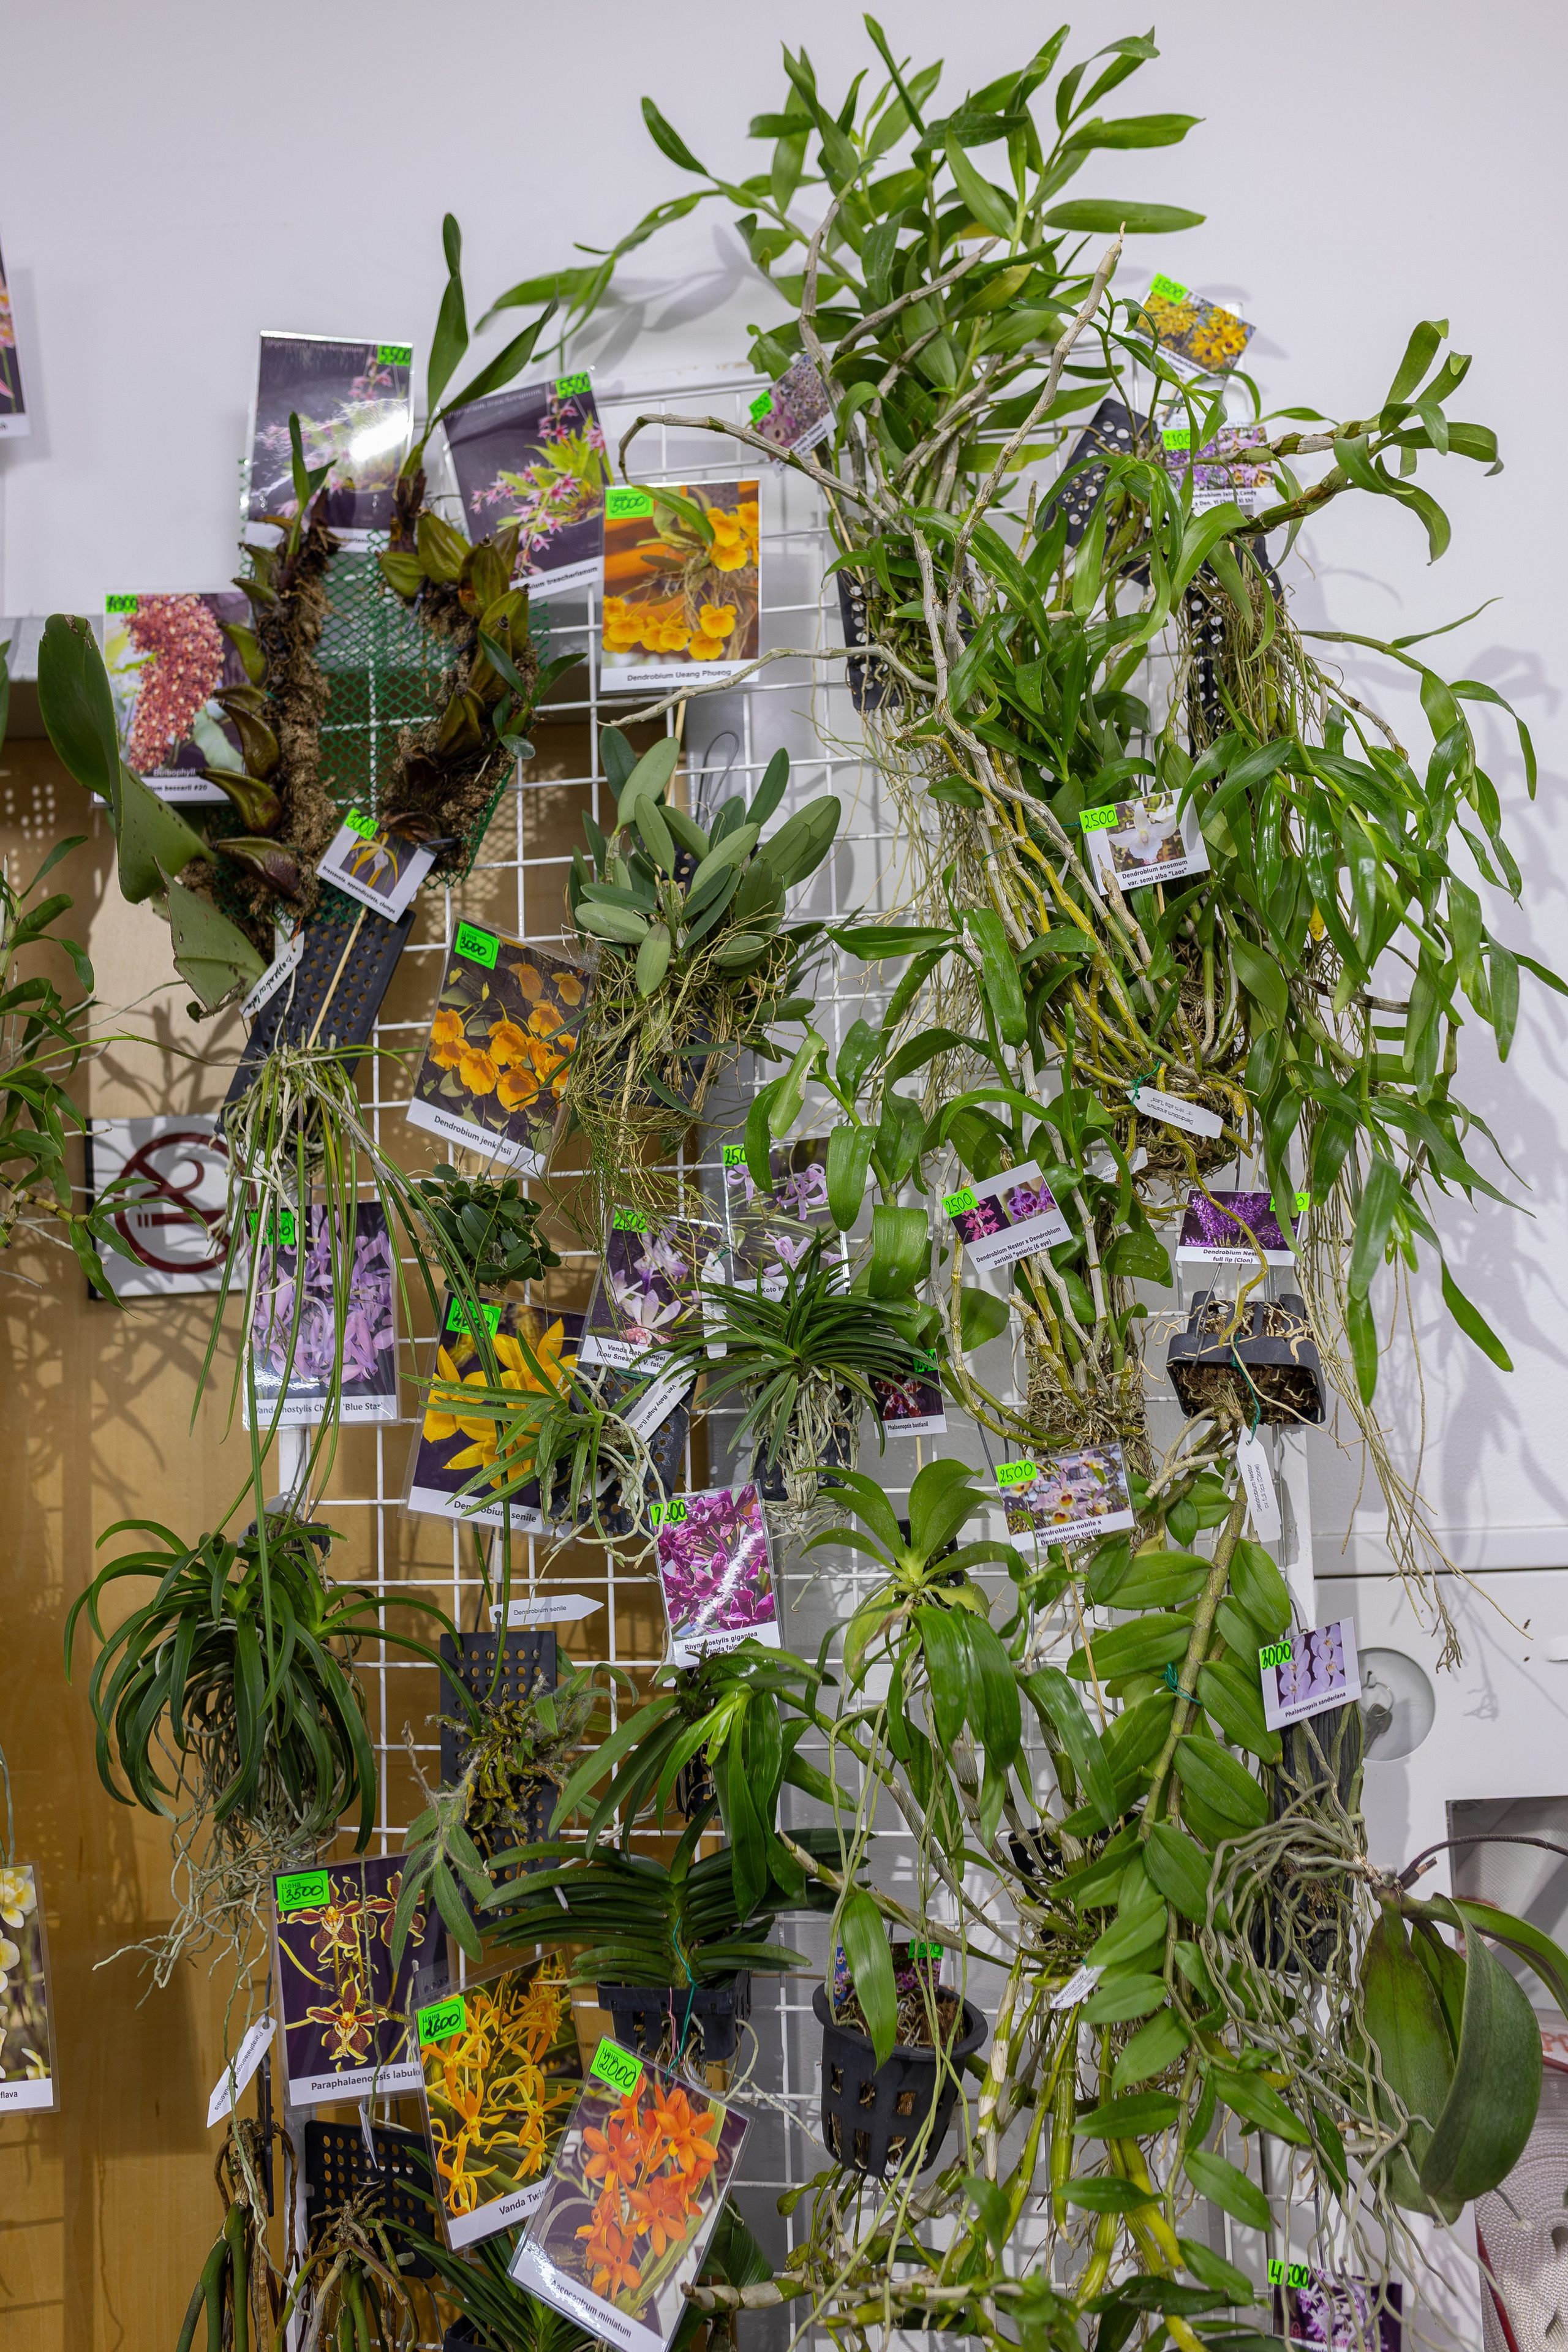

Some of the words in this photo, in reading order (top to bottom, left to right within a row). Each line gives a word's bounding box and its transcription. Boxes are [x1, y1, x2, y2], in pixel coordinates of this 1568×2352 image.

[627, 673, 674, 681] Dendrobium
[676, 671, 700, 679] Ueang
[153, 768, 196, 778] Bulbophyll
[1084, 809, 1115, 829] 2500
[1121, 867, 1158, 880] Dendrobium
[1159, 859, 1188, 870] anosmum
[1155, 872, 1167, 881] alba
[460, 937, 487, 956] 3000
[434, 1115, 480, 1141] Dendrobium
[725, 1147, 747, 1165] 250
[945, 1192, 972, 1215] 2500
[976, 1248, 1008, 1263] Dendrobium
[1007, 1240, 1025, 1251] Nestor
[1028, 1226, 1061, 1242] Dendrobium
[993, 1253, 1013, 1266] parishii
[1040, 1238, 1052, 1250] eye)
[608, 1344, 627, 1354] Vanda
[656, 1395, 668, 1407] Baby
[645, 1406, 658, 1422] Angel
[1000, 1463, 1033, 1483] 2500
[454, 1501, 505, 1517] Denobiu
[511, 1512, 537, 1523] senile
[1036, 1526, 1075, 1539] Dendrobium
[1076, 1520, 1096, 1530] nobile
[1041, 1533, 1080, 1546] Dendrobium
[1081, 1528, 1101, 1537] tortile
[513, 1607, 548, 1616] Dendrobium
[684, 1638, 729, 1651] Rhyncostylis
[730, 1631, 758, 1643] gigantea
[1261, 1642, 1292, 1670] 3000
[1284, 1702, 1317, 1718] Phalaenopsis
[1318, 1692, 1346, 1706] sanderiana
[285, 1885, 323, 1903] 3500
[425, 2013, 459, 2037] 2600
[599, 2052, 637, 2087] 2000
[499, 2198, 526, 2215] Vanda
[598, 2310, 632, 2339] miniatum
